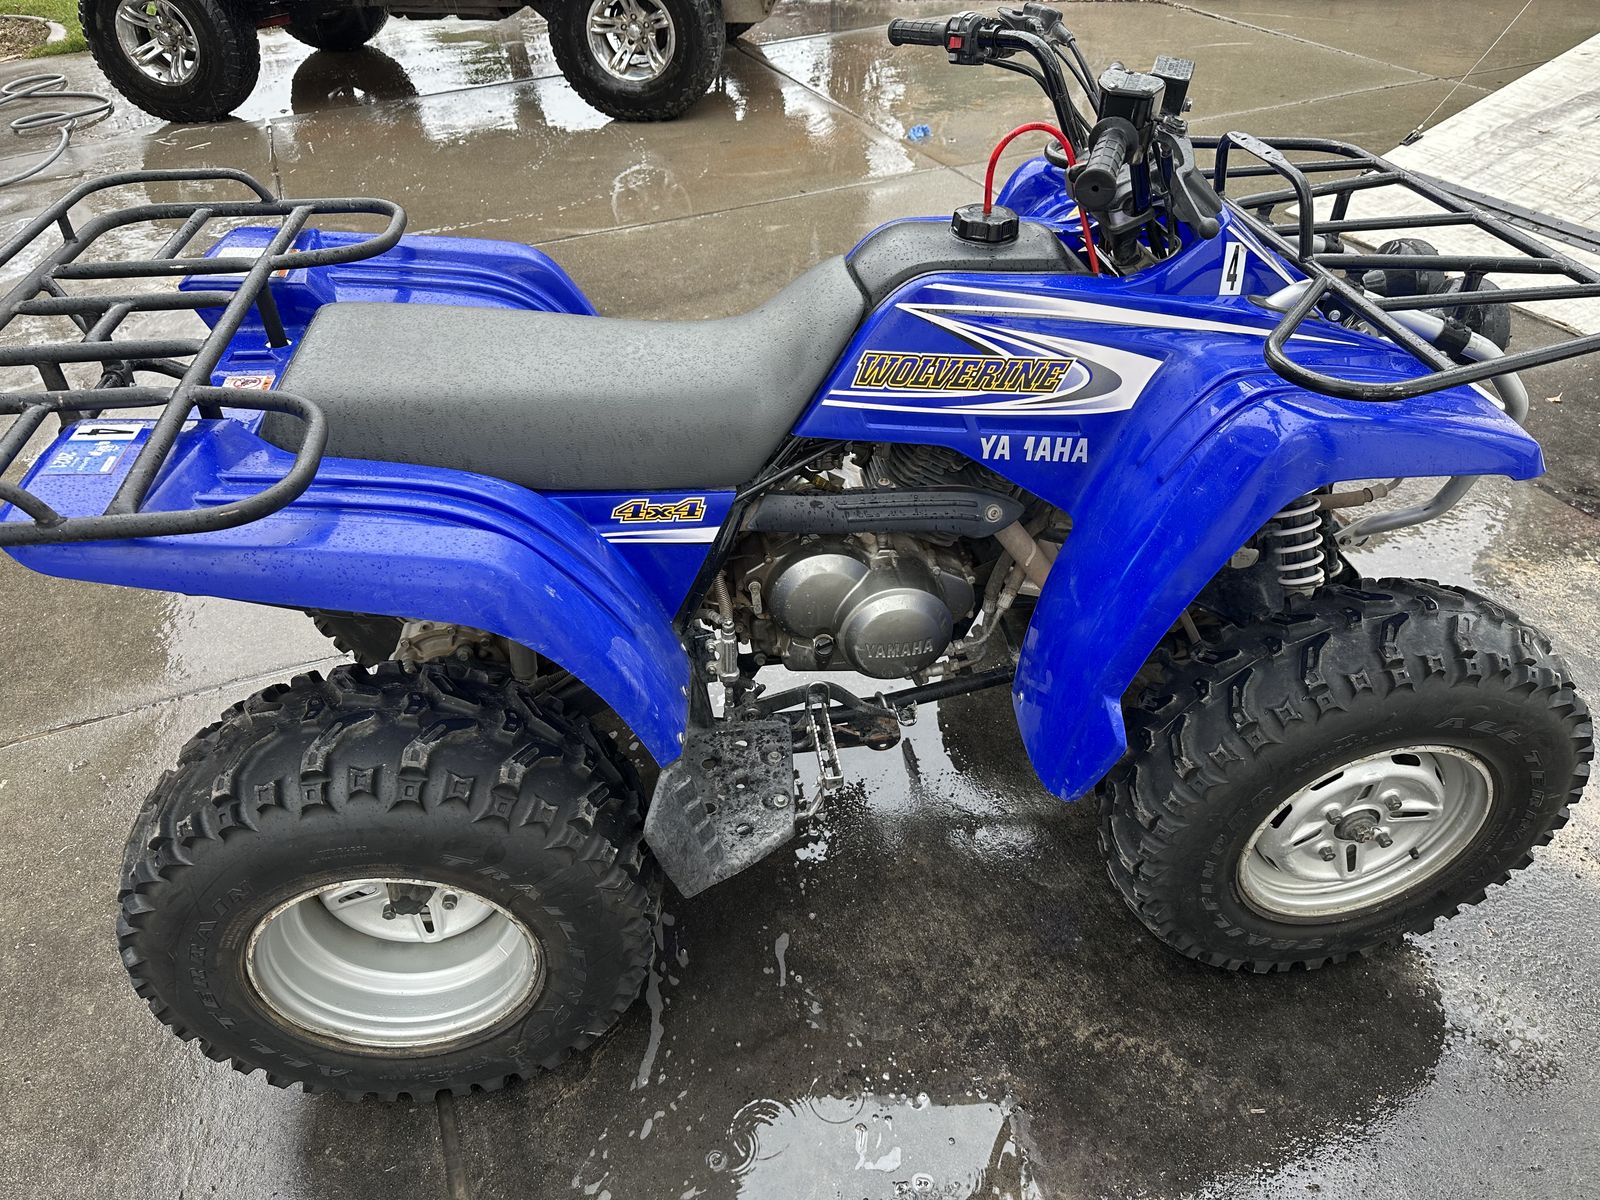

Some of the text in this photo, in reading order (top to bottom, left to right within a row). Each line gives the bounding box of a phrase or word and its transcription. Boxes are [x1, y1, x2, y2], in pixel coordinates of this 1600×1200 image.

[1226, 244, 1240, 291] 4
[852, 350, 1075, 393] WOLVERINE
[77, 428, 135, 436] 4
[611, 497, 707, 524] 4x4
[865, 638, 933, 659] YAMAHA
[1432, 717, 1521, 745] ALL
[188, 880, 255, 1030] TERRAIN
[249, 1036, 353, 1079] ALL
